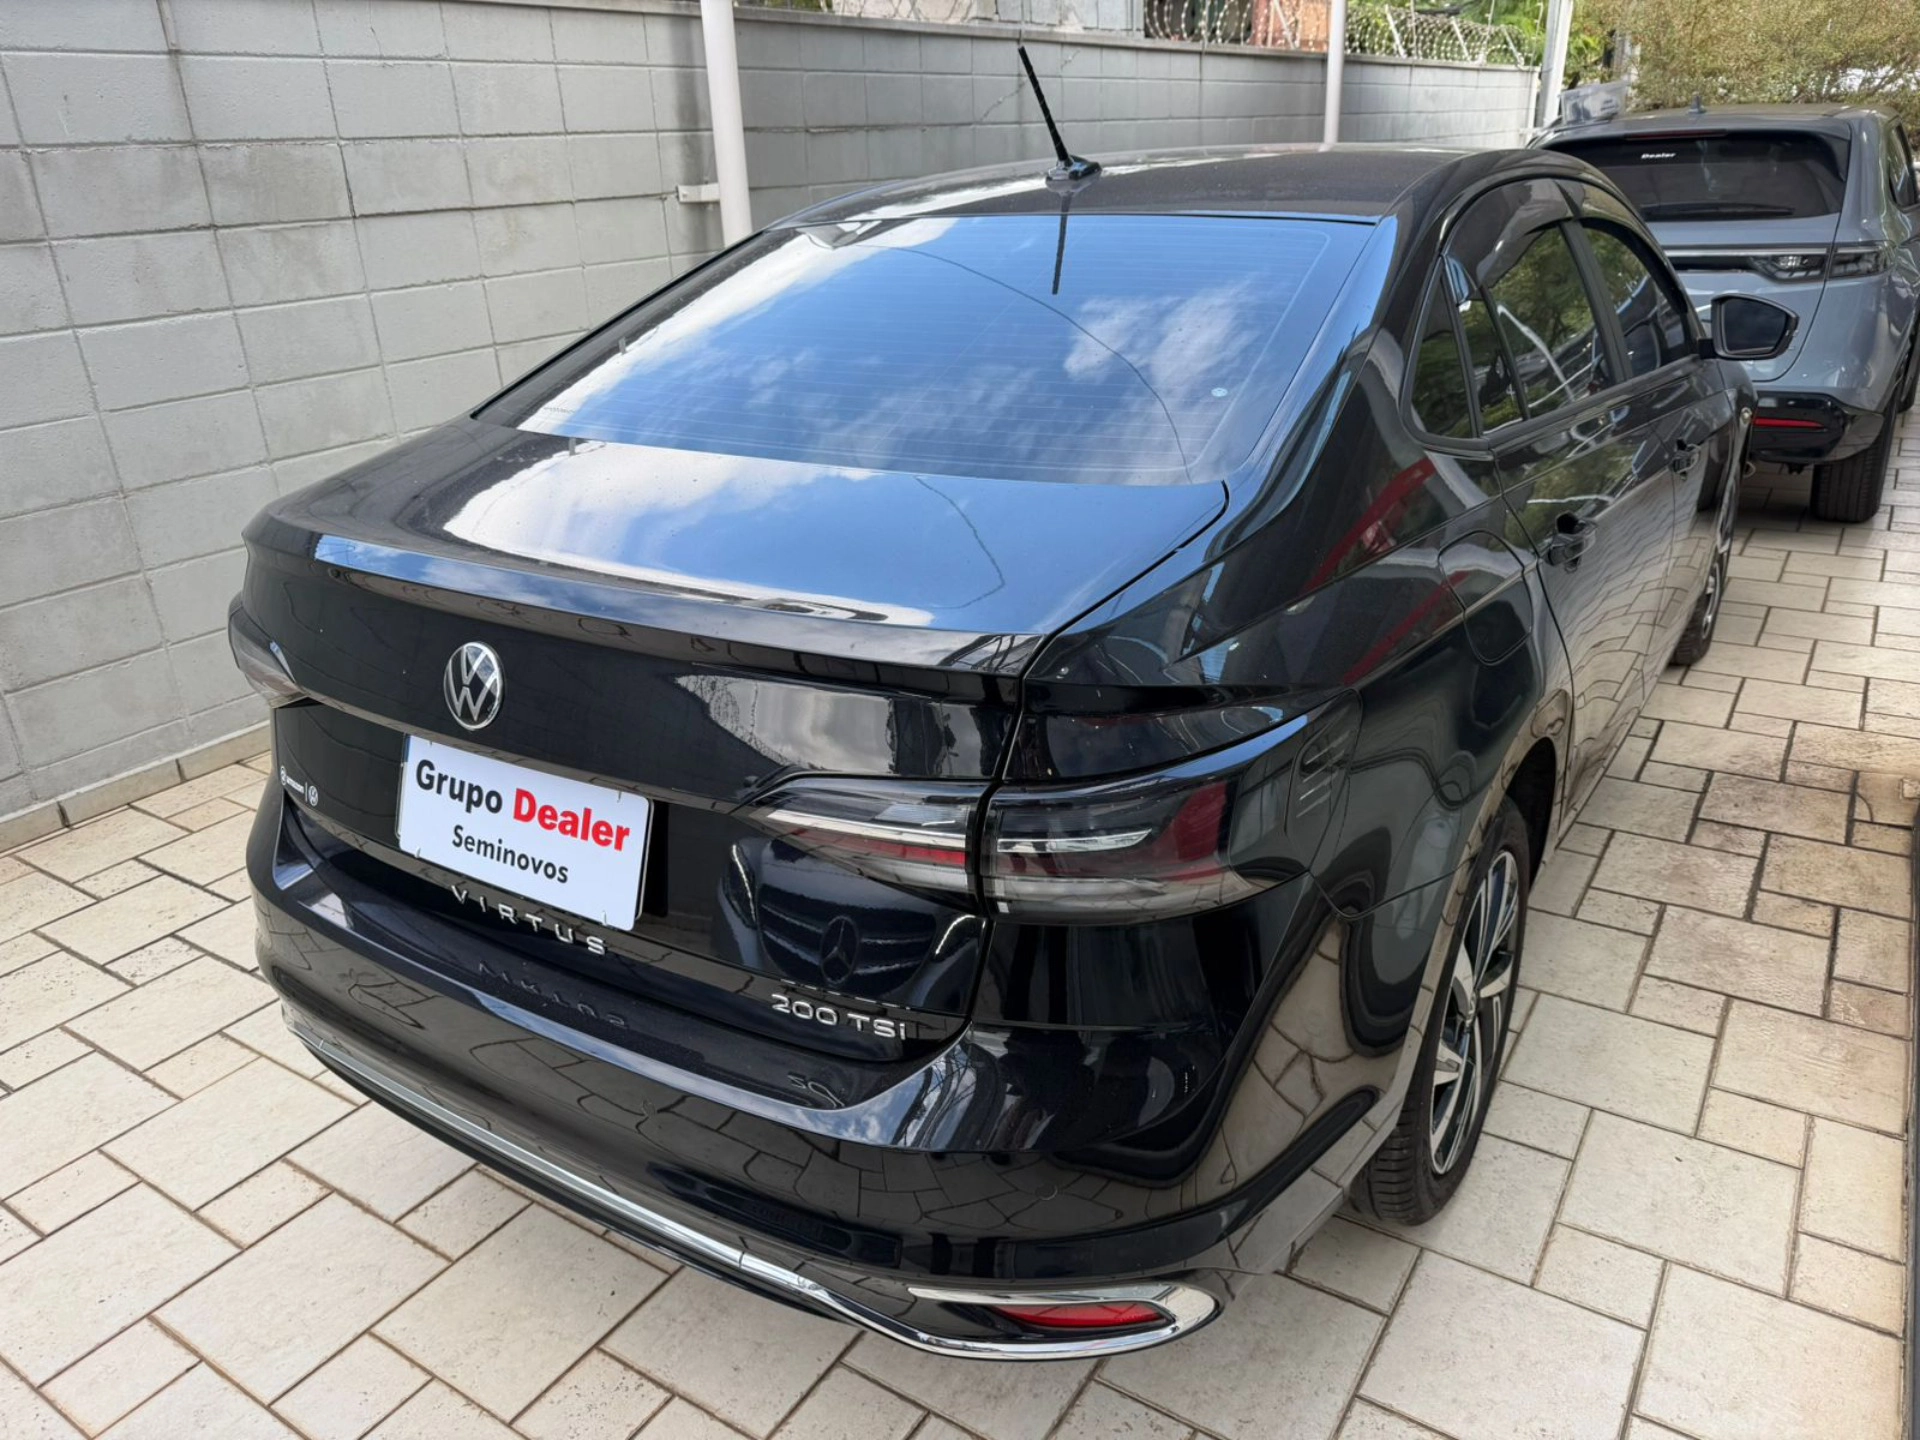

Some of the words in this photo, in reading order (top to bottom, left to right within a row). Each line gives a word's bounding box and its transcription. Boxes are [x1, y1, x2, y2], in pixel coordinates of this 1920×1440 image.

[416, 760, 503, 813] Grupo
[513, 788, 630, 851] Dealer
[452, 825, 569, 883] Seminovos
[451, 885, 606, 955] VIRTUS
[771, 993, 838, 1026] 200
